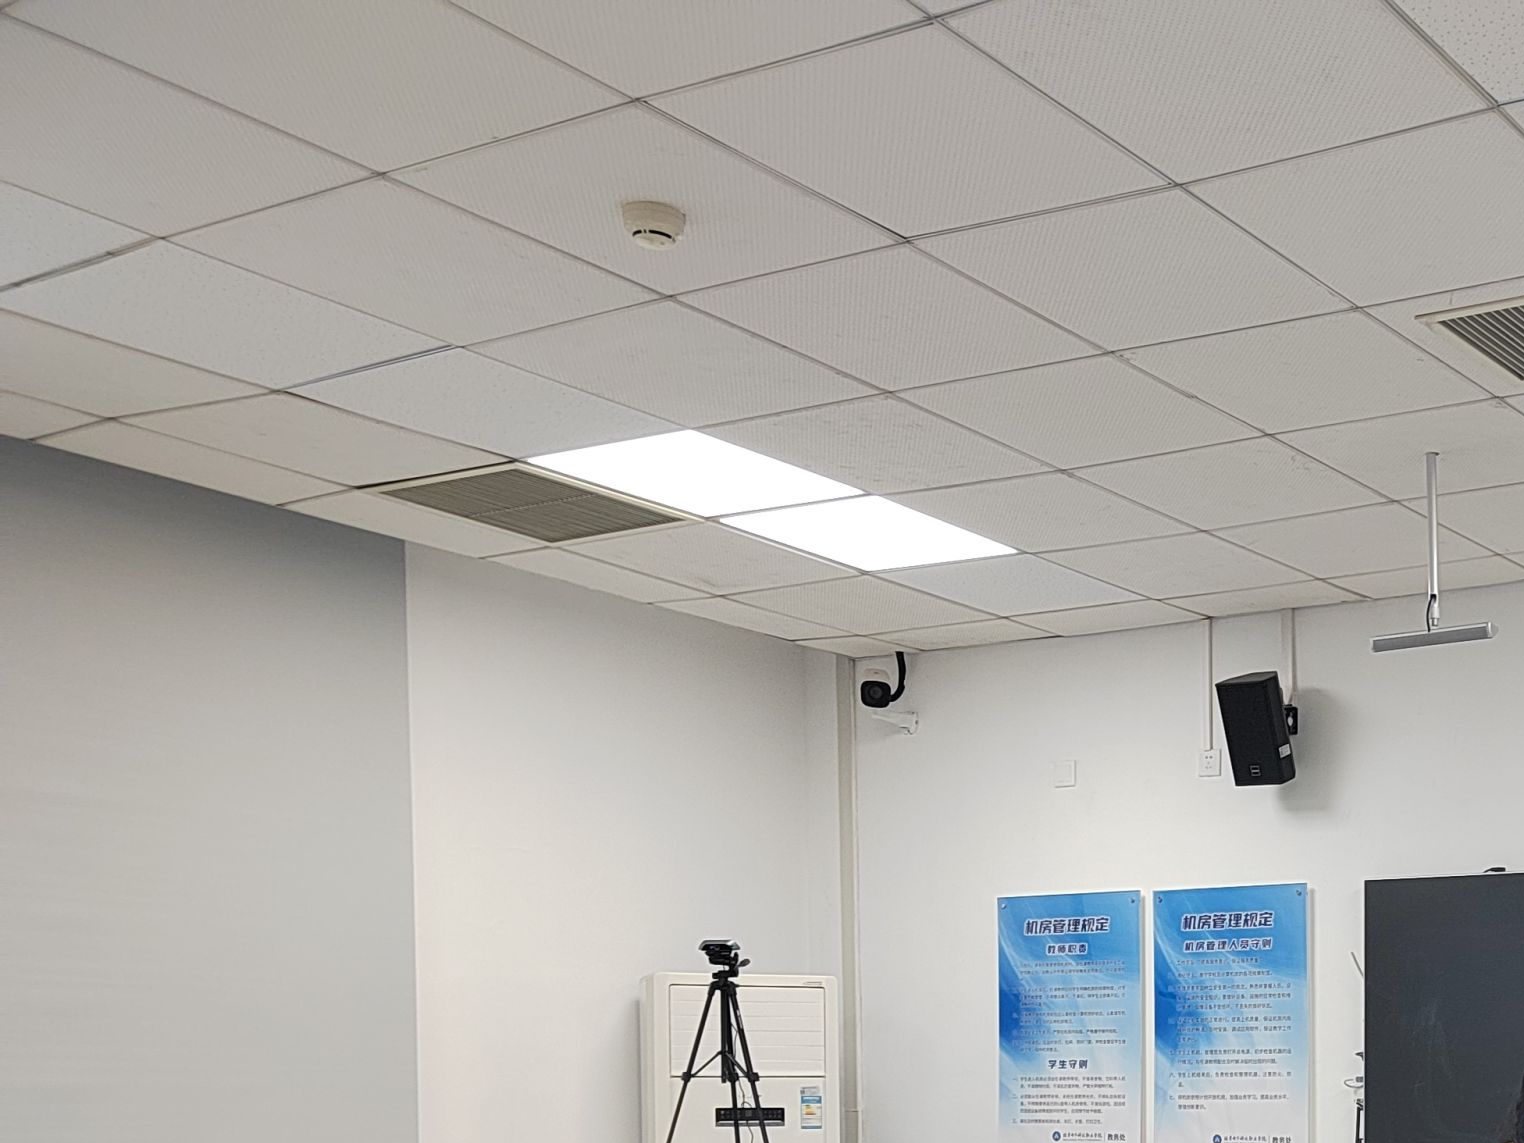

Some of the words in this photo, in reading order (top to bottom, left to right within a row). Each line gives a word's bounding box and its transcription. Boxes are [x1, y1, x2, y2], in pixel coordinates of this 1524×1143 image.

[1025, 917, 1110, 935] 机房管理规定
[1182, 911, 1274, 931] 机房管理规定
[1184, 938, 1273, 952] 机房管理人员守则
[1048, 1059, 1089, 1070] 学生守则
